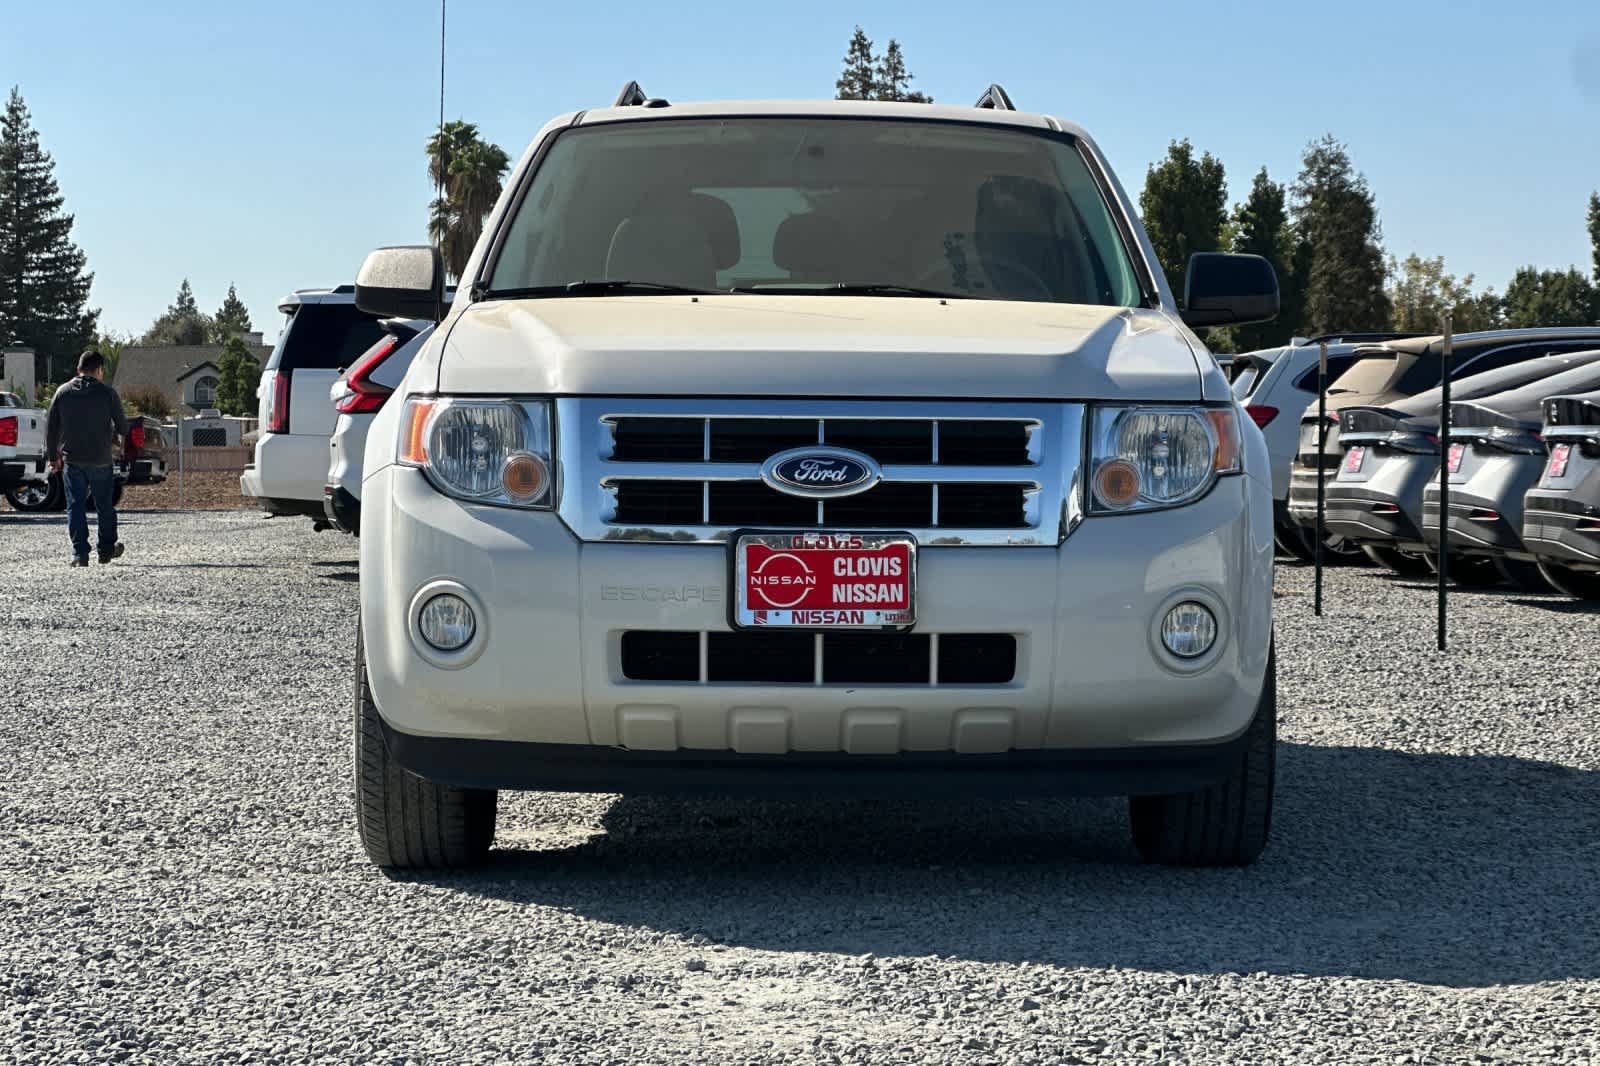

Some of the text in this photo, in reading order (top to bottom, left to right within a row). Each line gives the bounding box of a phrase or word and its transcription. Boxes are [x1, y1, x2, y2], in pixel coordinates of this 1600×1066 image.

[794, 459, 848, 481] Ford
[792, 535, 863, 549] CLOVIS
[833, 557, 902, 577] CLOVIS
[751, 576, 816, 585] NISSAN
[600, 584, 721, 602] ESCAPE
[832, 584, 903, 603] NISSAN
[792, 611, 864, 625] NISSAN
